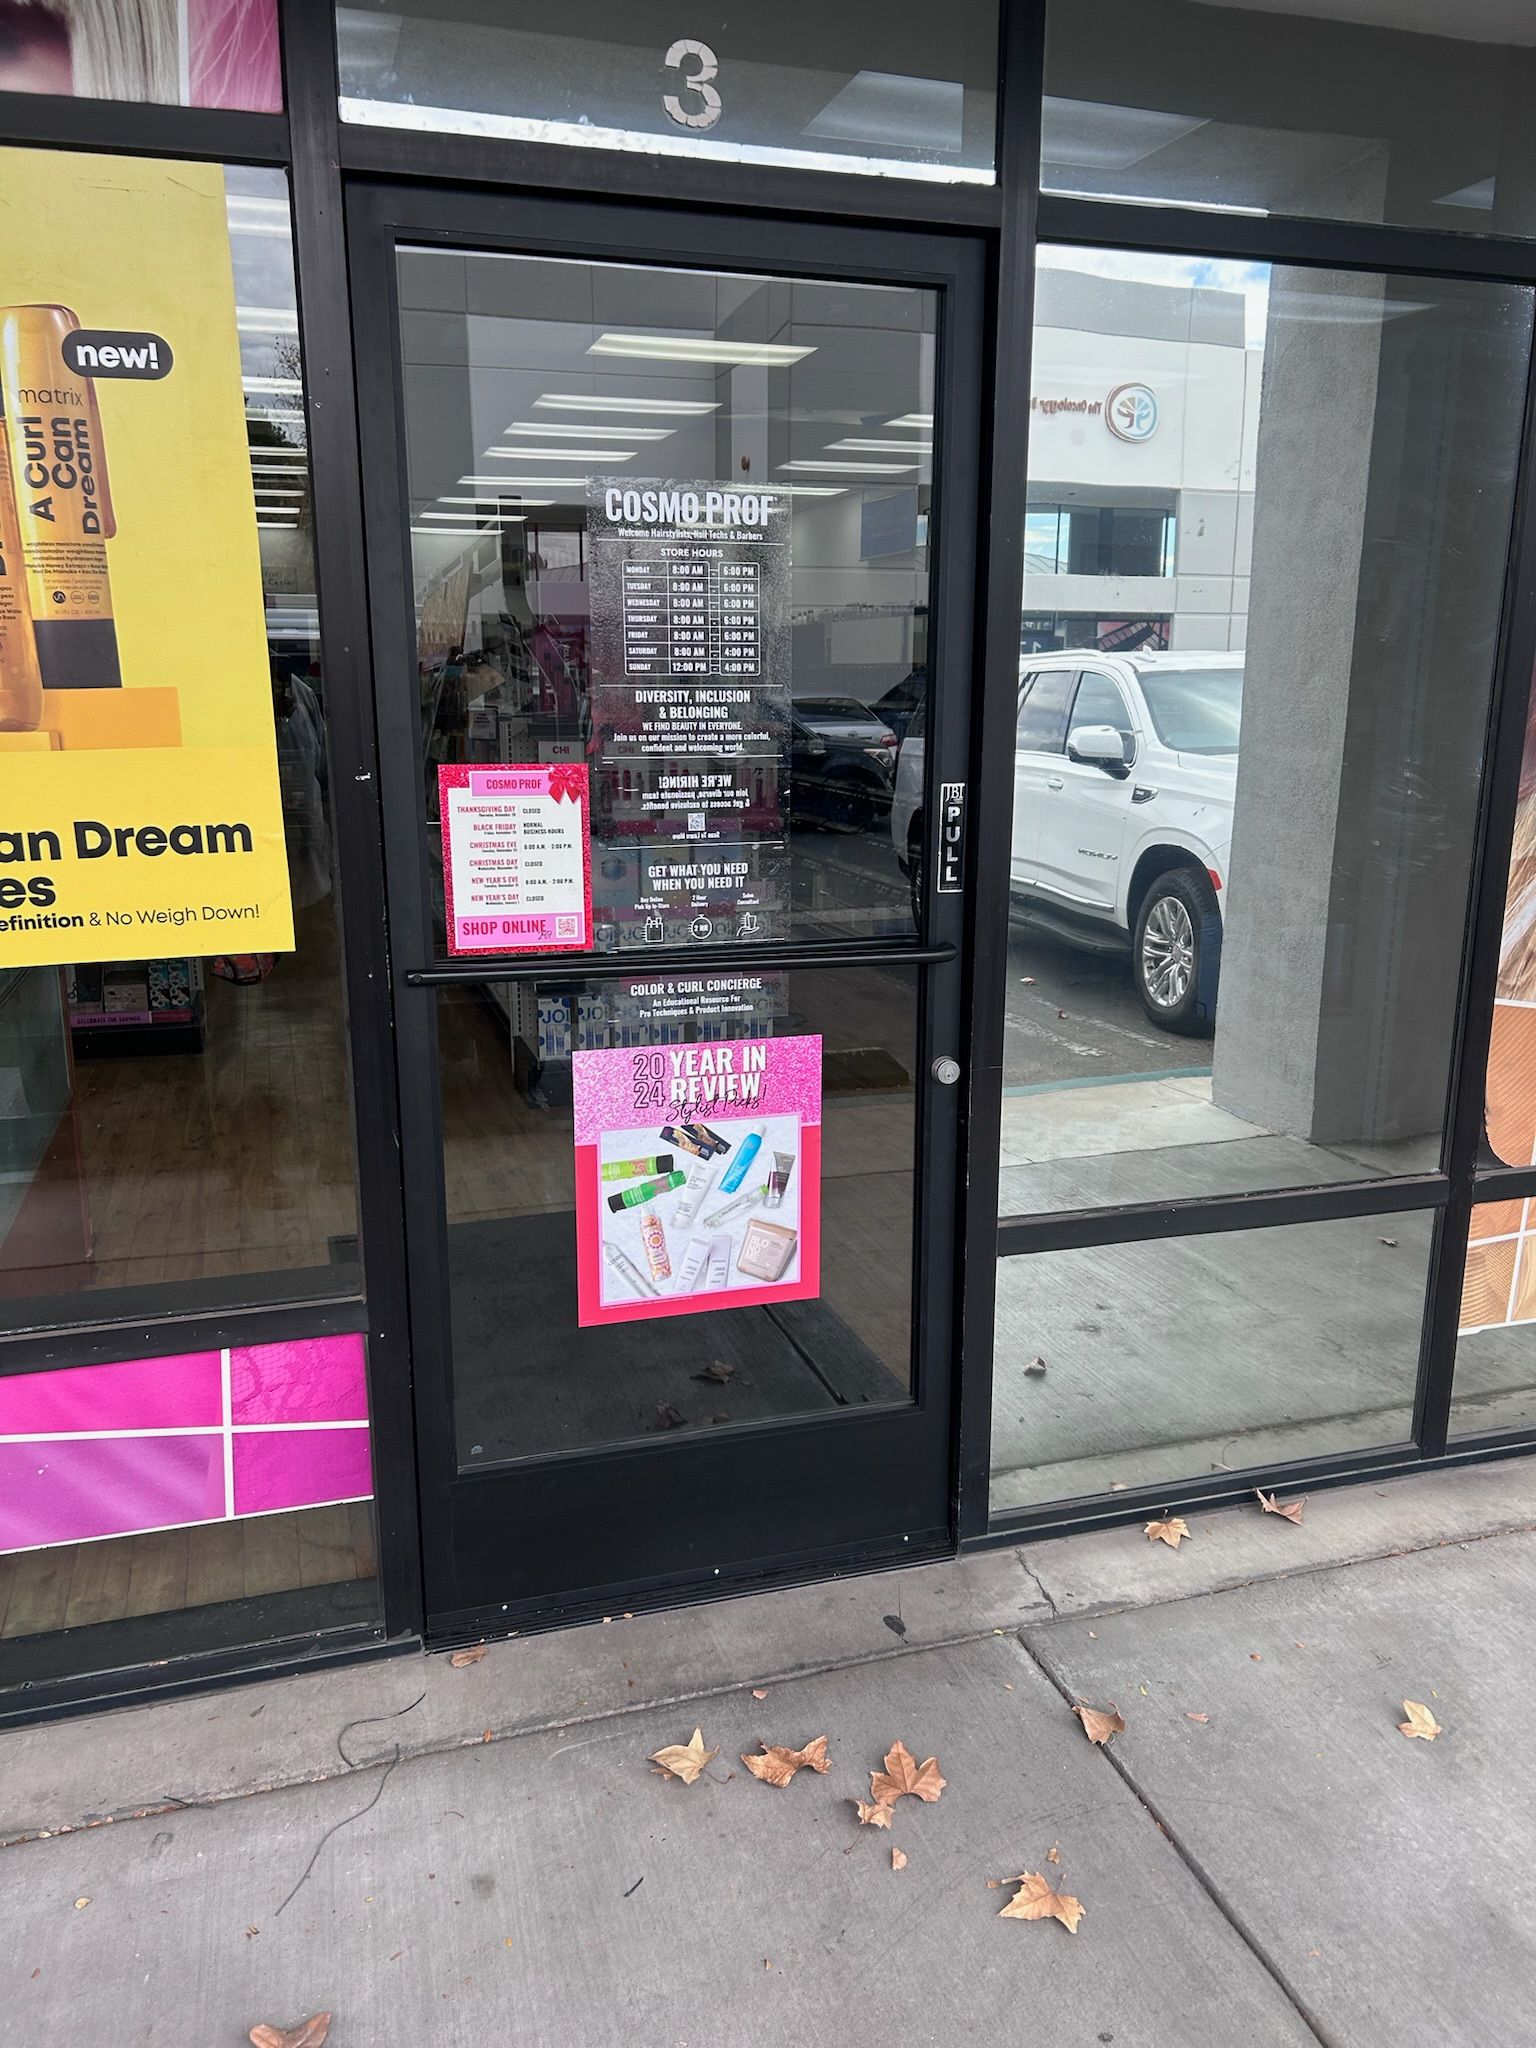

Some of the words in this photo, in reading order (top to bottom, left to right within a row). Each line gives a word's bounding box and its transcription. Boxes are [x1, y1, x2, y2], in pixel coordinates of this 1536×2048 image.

[663, 38, 722, 132] 3
[77, 343, 159, 369] new!
[18, 388, 83, 406] matrix
[17, 416, 50, 488] Curl
[51, 417, 77, 489] Can
[73, 419, 100, 534] Dream
[30, 497, 55, 522] A
[605, 488, 699, 523] COSMO
[706, 491, 774, 526] PROF
[618, 528, 649, 537] Welcome
[651, 529, 692, 539] Hairstylists,
[709, 531, 728, 539] Techs
[737, 531, 763, 540] Barbers
[660, 548, 689, 557] STORE
[692, 549, 723, 557] HOURS
[672, 565, 690, 575] 8:00
[692, 565, 703, 575] AM
[723, 566, 740, 576] 6:00
[742, 566, 754, 576] PM
[672, 582, 690, 591] 8:00
[692, 583, 703, 592] AM
[724, 583, 740, 593] 6:00
[742, 583, 754, 593] PM
[673, 599, 690, 608] 8:00
[692, 599, 703, 608] AM
[724, 599, 740, 609] 6:00
[743, 599, 754, 609] PM
[673, 615, 690, 624] 8:00
[692, 615, 704, 625] AM
[724, 615, 740, 625] 6:00
[743, 615, 754, 625] PM
[674, 632, 690, 641] 8:00
[693, 632, 704, 641] AM
[724, 632, 741, 641] 6:00
[743, 632, 754, 641] PM
[674, 648, 691, 657] 8:00
[693, 648, 704, 657] AM
[725, 648, 741, 657] 4:00
[743, 648, 754, 657] PM
[673, 663, 693, 671] 12:00
[695, 663, 706, 672] PM
[725, 663, 741, 672] 4:00
[743, 663, 754, 672] PM
[635, 690, 693, 705] DIVERSITY,
[696, 690, 751, 703] INCLUSION
[659, 707, 666, 719] &
[670, 706, 728, 719] BELONGING
[642, 723, 653, 731] WE
[654, 722, 670, 730] FIND
[671, 722, 697, 730] BEAUTY
[699, 722, 706, 730] IN
[708, 722, 743, 730] EVERYONE.
[613, 733, 627, 742] Join
[661, 733, 687, 741] mission
[689, 733, 695, 741] to
[743, 732, 770, 741] colorful,
[552, 746, 570, 754] CHI
[641, 743, 672, 752] confident
[674, 744, 687, 752] and
[688, 743, 723, 753] welcoming
[725, 743, 744, 751] world.
[487, 779, 517, 789] COSMO
[519, 779, 542, 789] PROF
[73, 821, 254, 859] Dream
[946, 806, 960, 881] PULL
[648, 865, 667, 877] GET
[670, 864, 698, 877] WHAT
[700, 864, 721, 876] YOU
[724, 863, 748, 875] NEED
[653, 878, 682, 891] WHEN
[685, 877, 704, 889] YOU
[708, 877, 732, 888] NEED
[735, 876, 745, 887] IT
[89, 912, 101, 927] &
[106, 910, 133, 926] No
[137, 907, 196, 926] Weigh
[202, 904, 259, 921] Down!
[463, 922, 497, 935] SHOP
[503, 920, 546, 934] ONLINE
[631, 983, 665, 996] COLOR
[668, 983, 675, 994] &
[677, 981, 704, 993] CURL
[707, 978, 762, 991] CONCIERGE
[663, 996, 699, 1006] Educational
[701, 995, 729, 1004] Resource
[731, 995, 741, 1003] For
[640, 1010, 651, 1018] Pro
[653, 1006, 687, 1018] Techniques
[689, 1007, 694, 1015] &
[696, 1005, 720, 1014] Product
[721, 1003, 753, 1013] Innovation
[633, 1052, 665, 1081] 20
[670, 1048, 734, 1078] YEAR
[743, 1045, 766, 1072] IN
[634, 1080, 665, 1109] 24
[671, 1072, 761, 1103] REVIEW
[666, 1095, 720, 1123] Stylist
